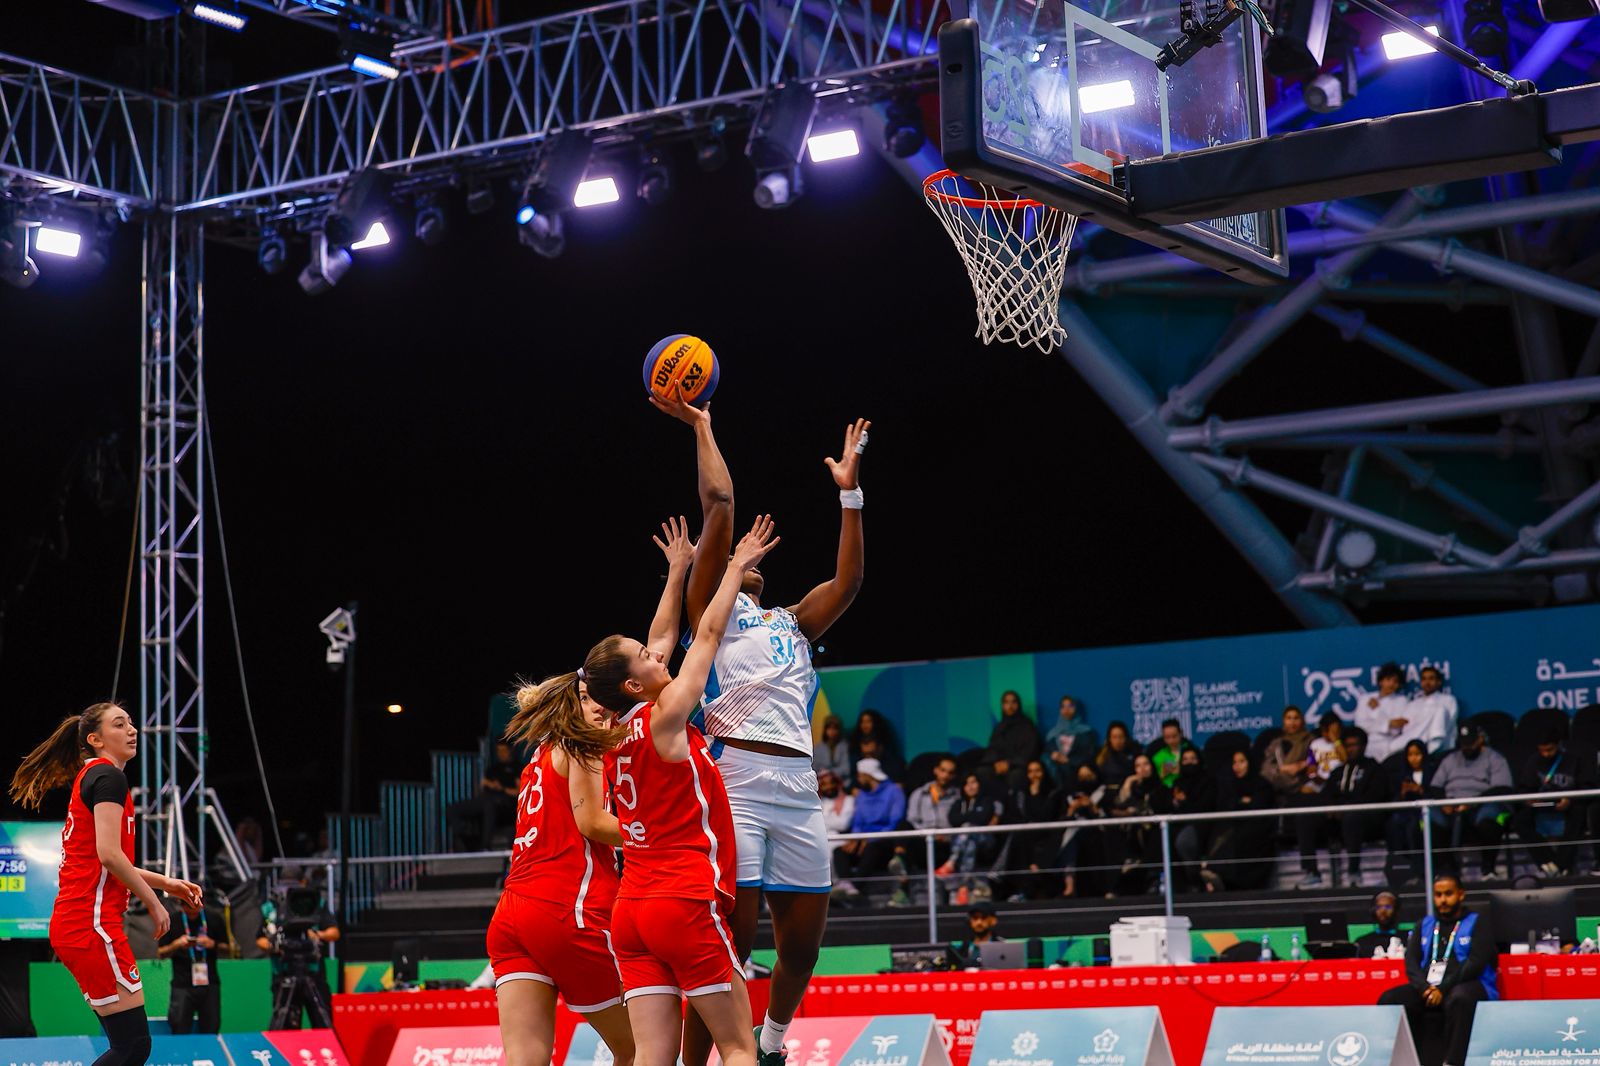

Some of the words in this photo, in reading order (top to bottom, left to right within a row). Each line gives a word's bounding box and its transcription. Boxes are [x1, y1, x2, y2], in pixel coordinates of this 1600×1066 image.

[654, 343, 692, 388] Wilson
[1193, 680, 1239, 695] ISLAMIC
[1194, 691, 1264, 708] SOLIDARITY
[1537, 687, 1591, 710] ONE
[1195, 706, 1239, 720] SPORTS
[1196, 716, 1273, 733] ASSOCIATION
[614, 756, 638, 811] 5
